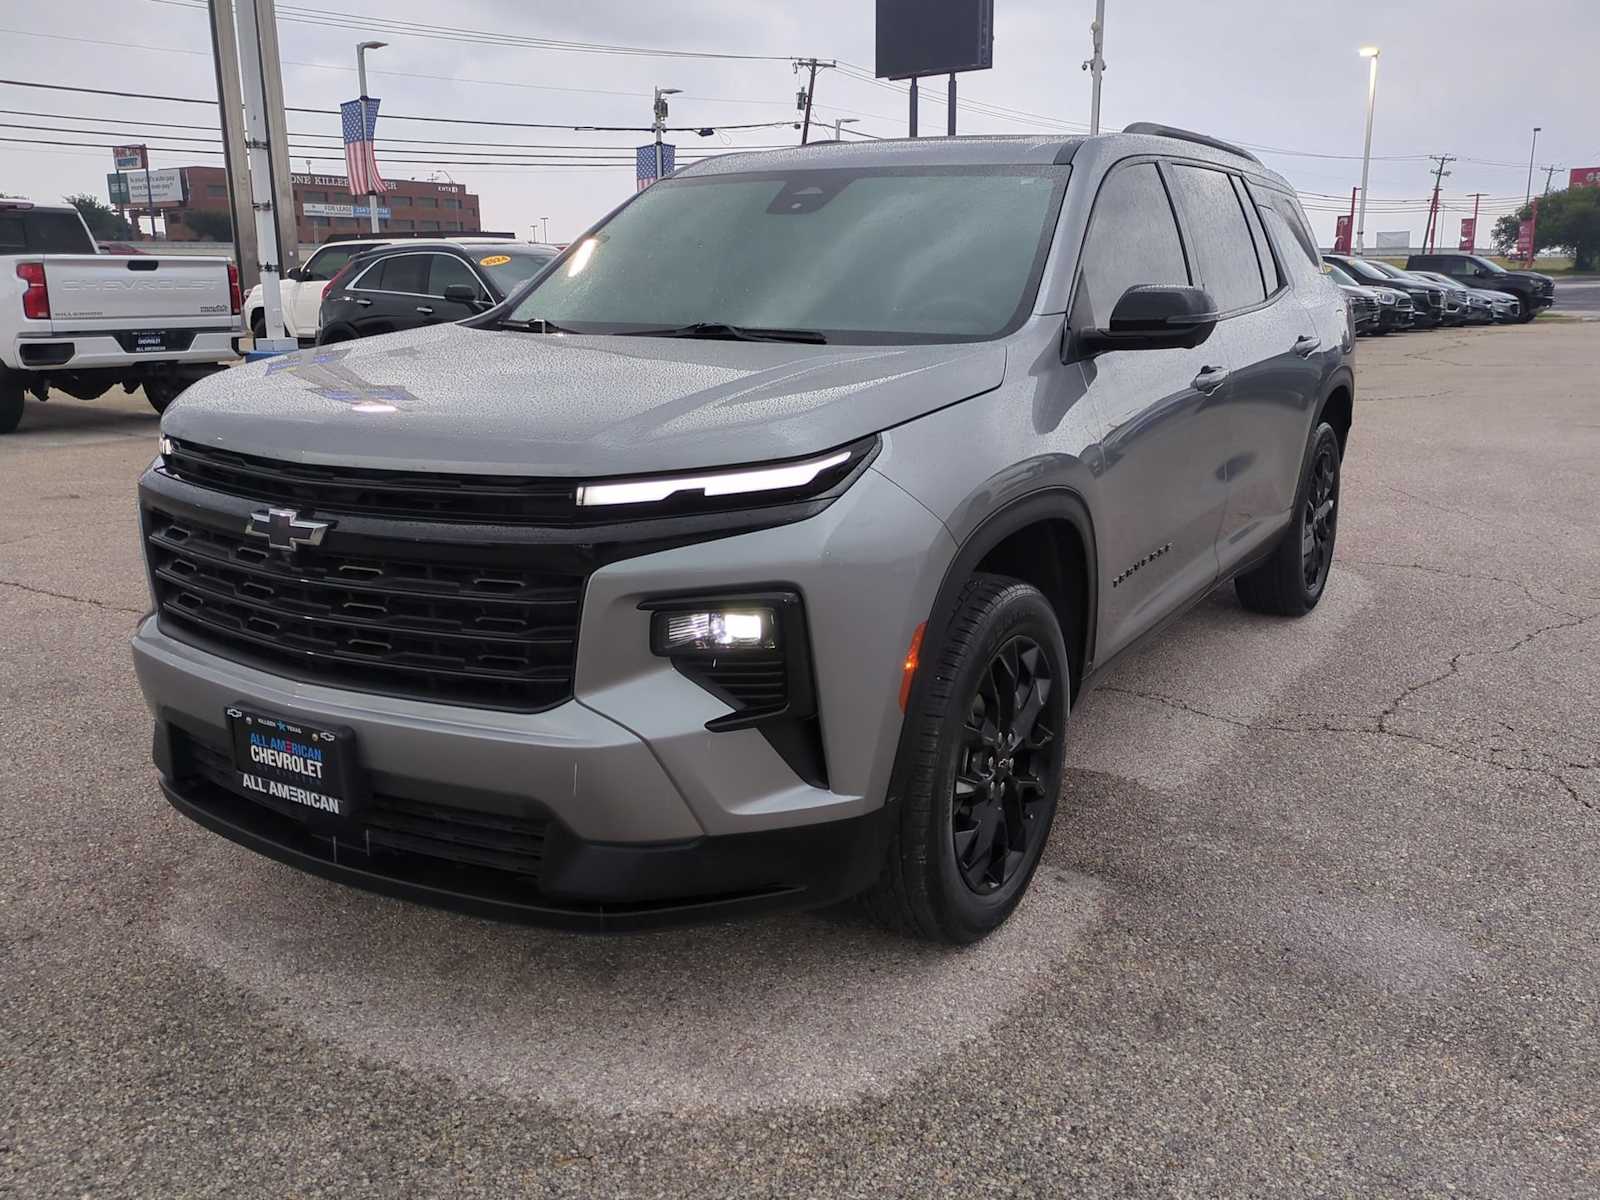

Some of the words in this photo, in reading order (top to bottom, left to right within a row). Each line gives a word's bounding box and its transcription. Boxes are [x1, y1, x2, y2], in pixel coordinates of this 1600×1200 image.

[62, 279, 221, 291] CHEVROLET
[250, 732, 269, 748] ALL
[270, 736, 321, 762] AMERICAN
[250, 744, 323, 779] CHEVROLET
[242, 773, 267, 794] ALL
[269, 781, 340, 815] AMERICAN
